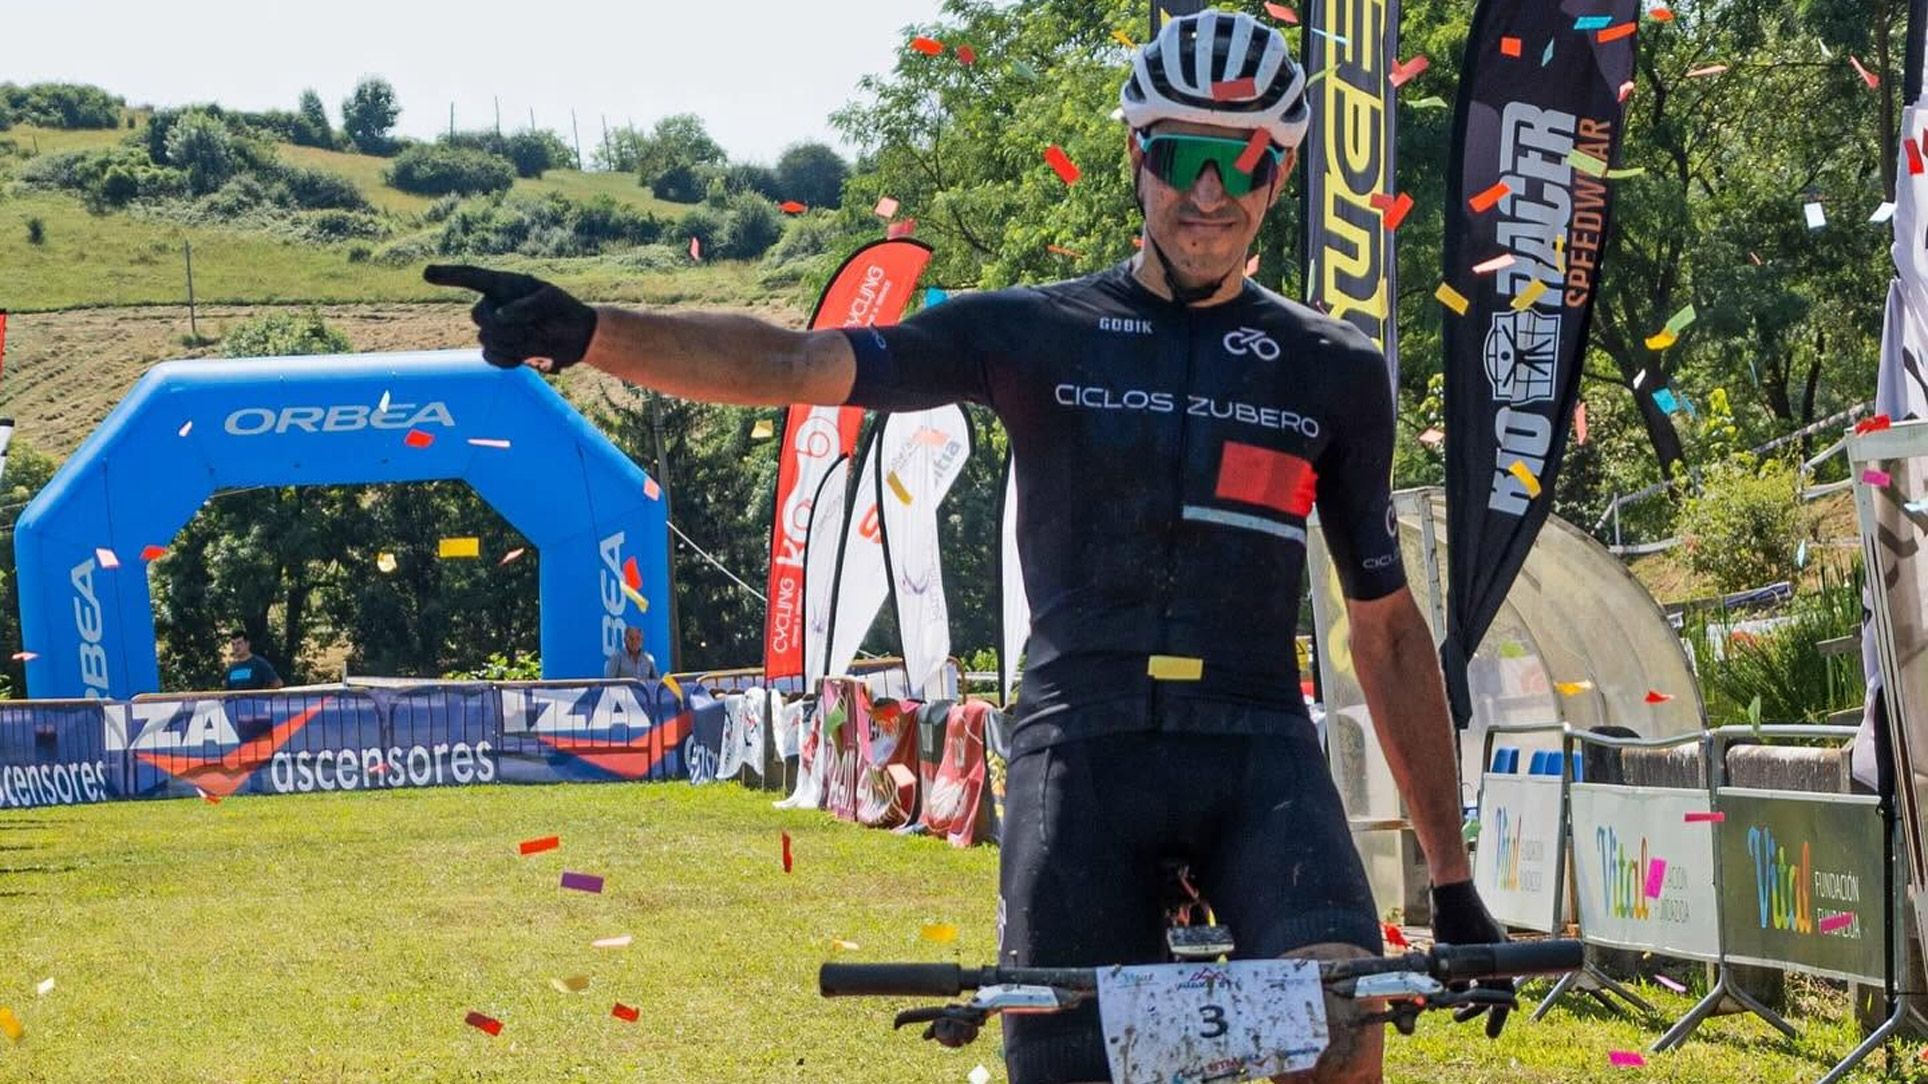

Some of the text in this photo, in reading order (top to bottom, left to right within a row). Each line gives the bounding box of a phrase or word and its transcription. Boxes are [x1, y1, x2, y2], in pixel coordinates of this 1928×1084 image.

[1496, 101, 1576, 307] RACER
[843, 265, 885, 328] YCLING
[1099, 316, 1153, 335] GOBIK
[223, 401, 456, 436] ORBEA
[1054, 383, 1320, 439] CICLOS ZUBERO
[70, 557, 109, 700] BEA
[600, 530, 628, 678] BEA
[772, 577, 796, 654] CYCLING
[104, 701, 229, 751] IZA
[501, 685, 652, 733] IZA
[0, 760, 106, 806] censores
[271, 739, 495, 793] ascensores
[1747, 824, 1812, 934] Vital
[1198, 1004, 1229, 1039] 3
